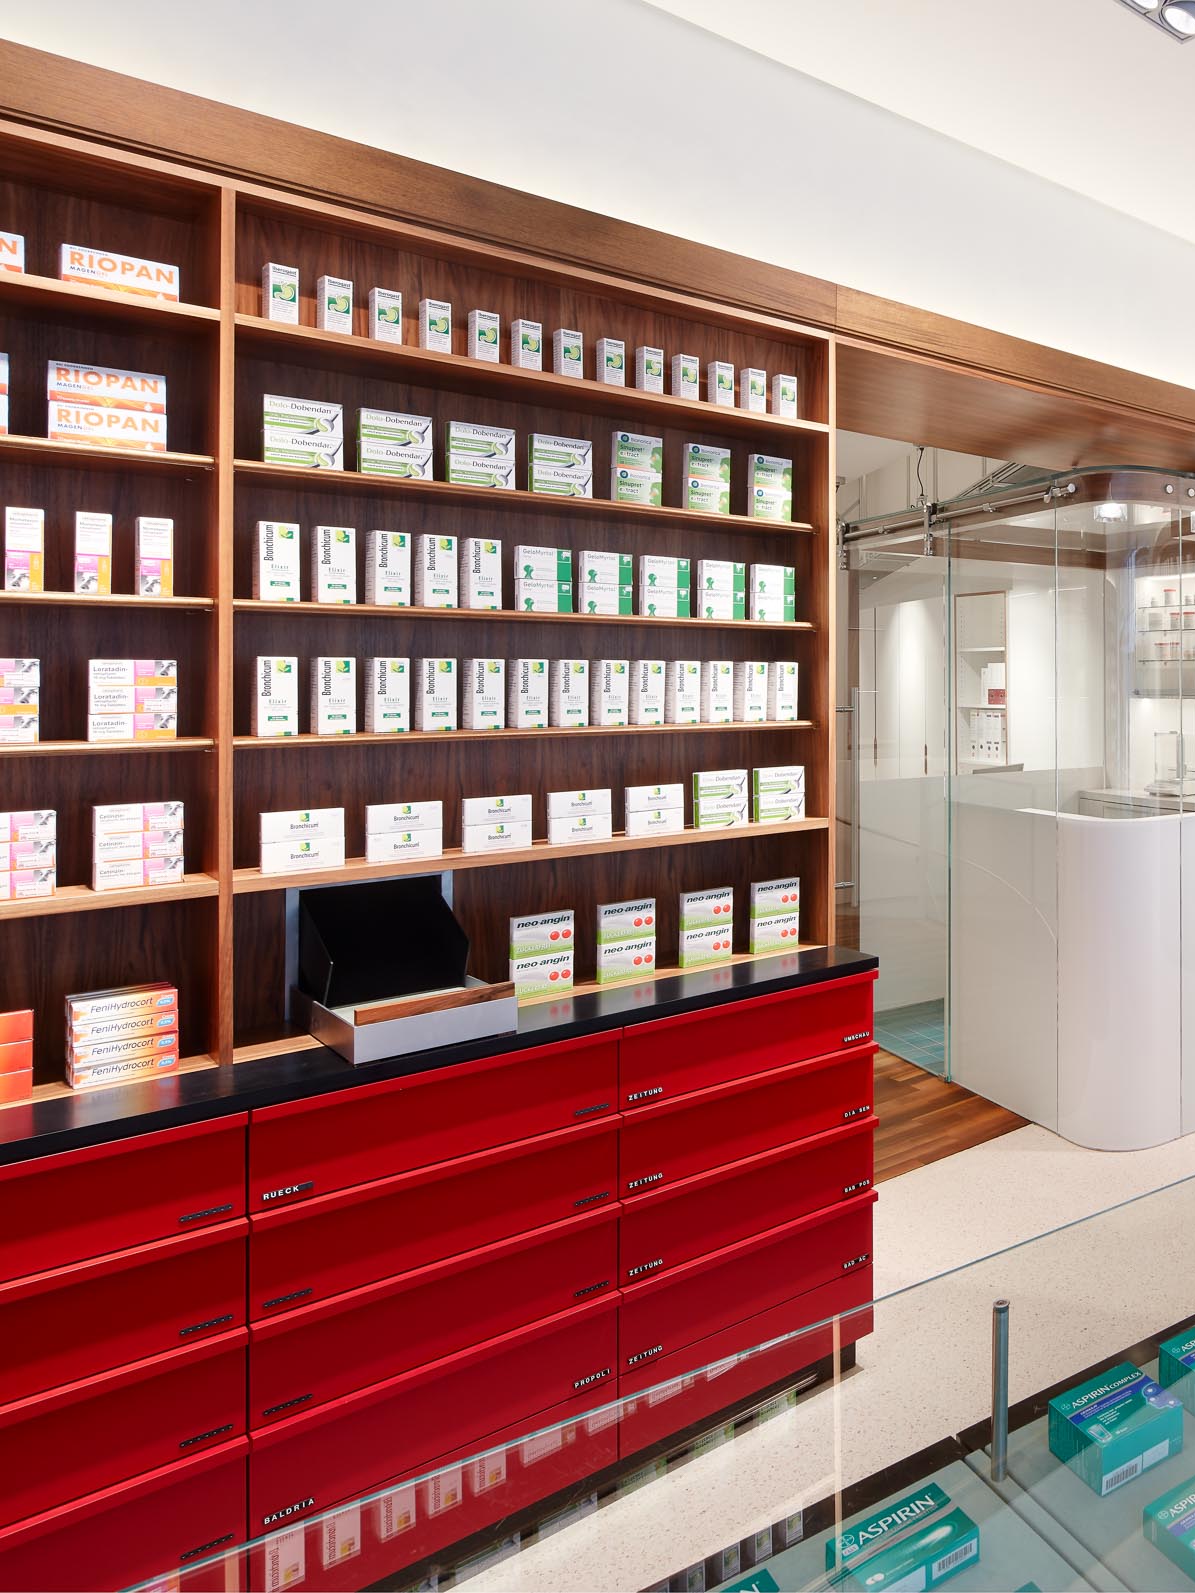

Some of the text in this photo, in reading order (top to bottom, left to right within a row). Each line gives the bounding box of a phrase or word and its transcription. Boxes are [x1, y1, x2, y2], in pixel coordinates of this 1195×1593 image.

[70, 250, 174, 284] RIOPAN
[56, 367, 158, 394] RIOPAN
[57, 408, 159, 433] RIOPAN
[264, 524, 273, 561] Bronchicum
[322, 529, 331, 565] Bronchicum
[379, 533, 388, 568] Bronchicum
[427, 537, 436, 571] Bronchicum
[473, 540, 481, 573] Bronchicum
[262, 660, 271, 697] Bronchicum
[322, 660, 331, 696] Bronchicum
[378, 660, 387, 695] Bronchicum
[426, 660, 435, 694] Bronchicum
[476, 661, 485, 694] Bronchicum
[521, 661, 529, 694] Bronchicum
[562, 662, 570, 694] Bronchicum
[290, 822, 318, 830] Bronchicum
[393, 814, 419, 822] Bronchicum
[290, 851, 318, 860] Bronchicum
[393, 842, 419, 850] Bronchicum
[90, 997, 153, 1013] FeniHydrocort
[91, 1017, 154, 1034] FeniHydrocort
[843, 1031, 870, 1042] UMSCHAU
[91, 1038, 154, 1055] FeniHydrocort
[91, 1058, 154, 1076] FeniHydrocort
[628, 1086, 663, 1101] ZEITUNG
[263, 1185, 300, 1201] RUECK
[628, 1172, 663, 1189] ZEITUNG
[628, 1258, 663, 1276] ZEITUNG
[628, 1345, 663, 1365] ZEITUNG
[574, 1368, 611, 1389] PROPOLI
[1072, 1385, 1109, 1409] ASPIRIN
[1109, 1371, 1142, 1389] COMPLEX
[264, 1497, 315, 1525] BALDRIA
[857, 1494, 935, 1546] ASPIRIN
